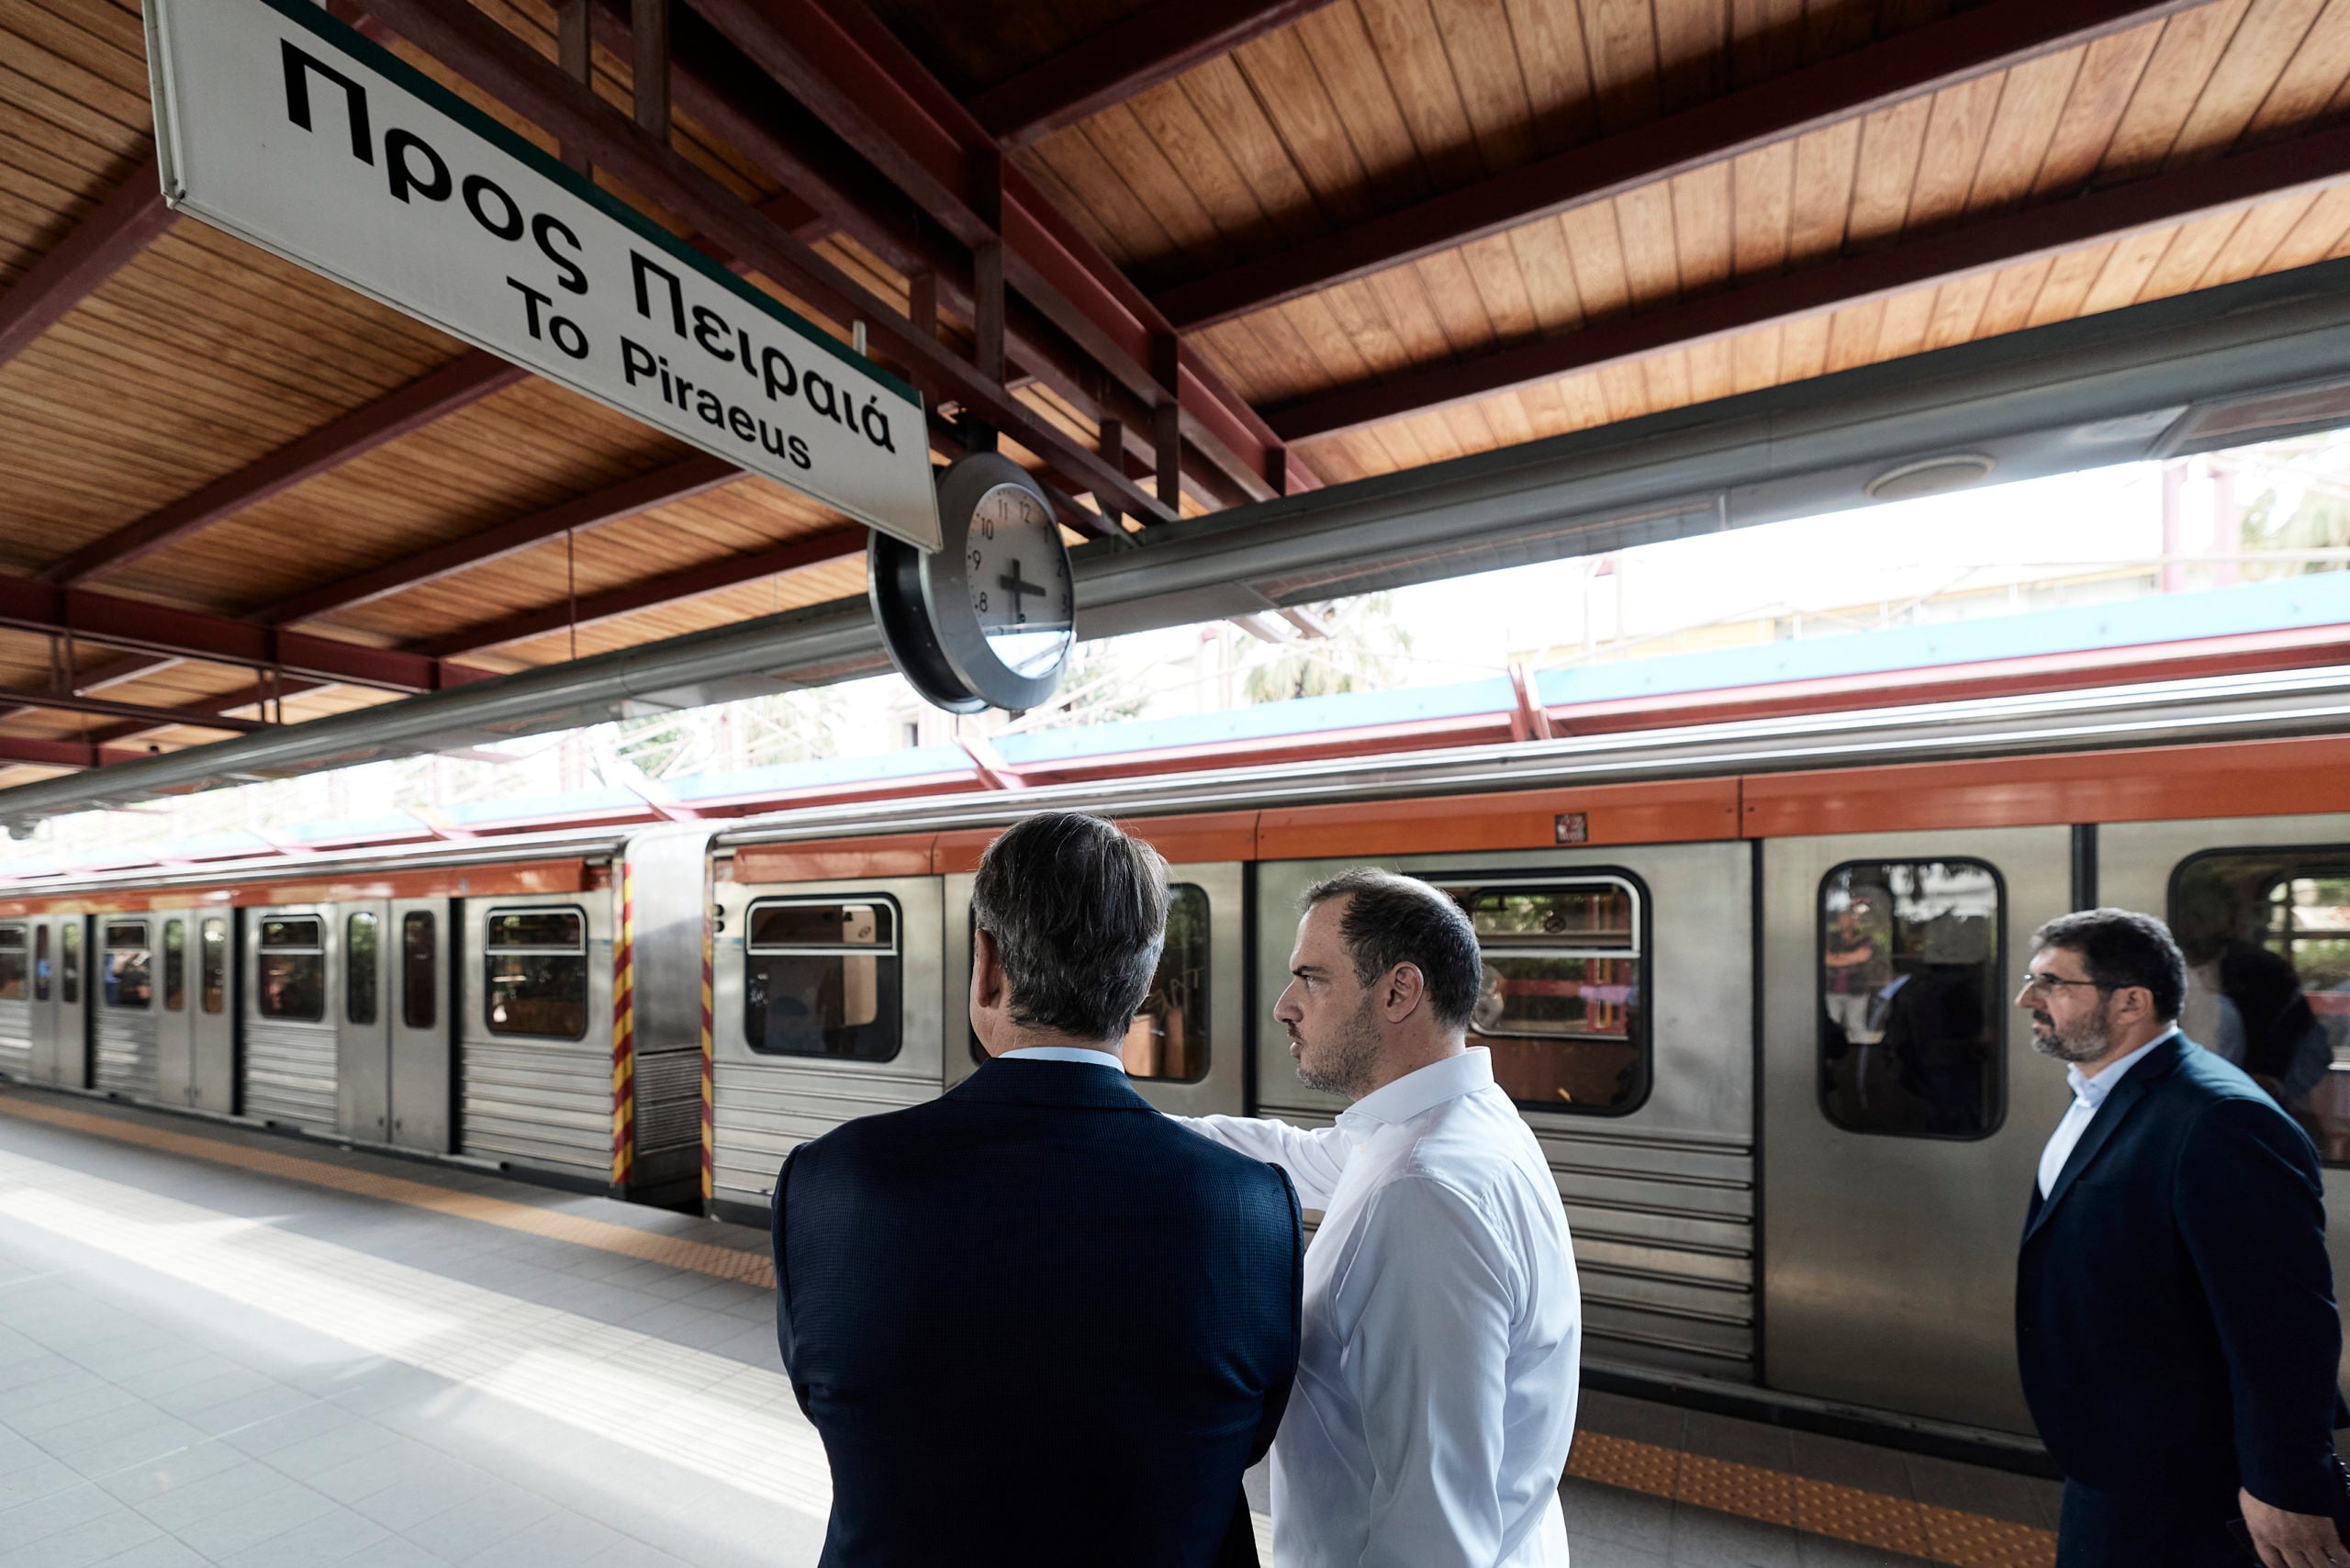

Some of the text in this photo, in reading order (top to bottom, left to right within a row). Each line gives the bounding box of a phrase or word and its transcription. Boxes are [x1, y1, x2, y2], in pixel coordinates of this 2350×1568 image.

[280, 38, 895, 454] Προς Πειραιά
[507, 276, 811, 469] To Piraeus
[998, 499, 1008, 521] 11
[1019, 501, 1031, 524] 12
[981, 517, 993, 540] 10
[973, 550, 981, 570] 9
[979, 591, 988, 613] 8
